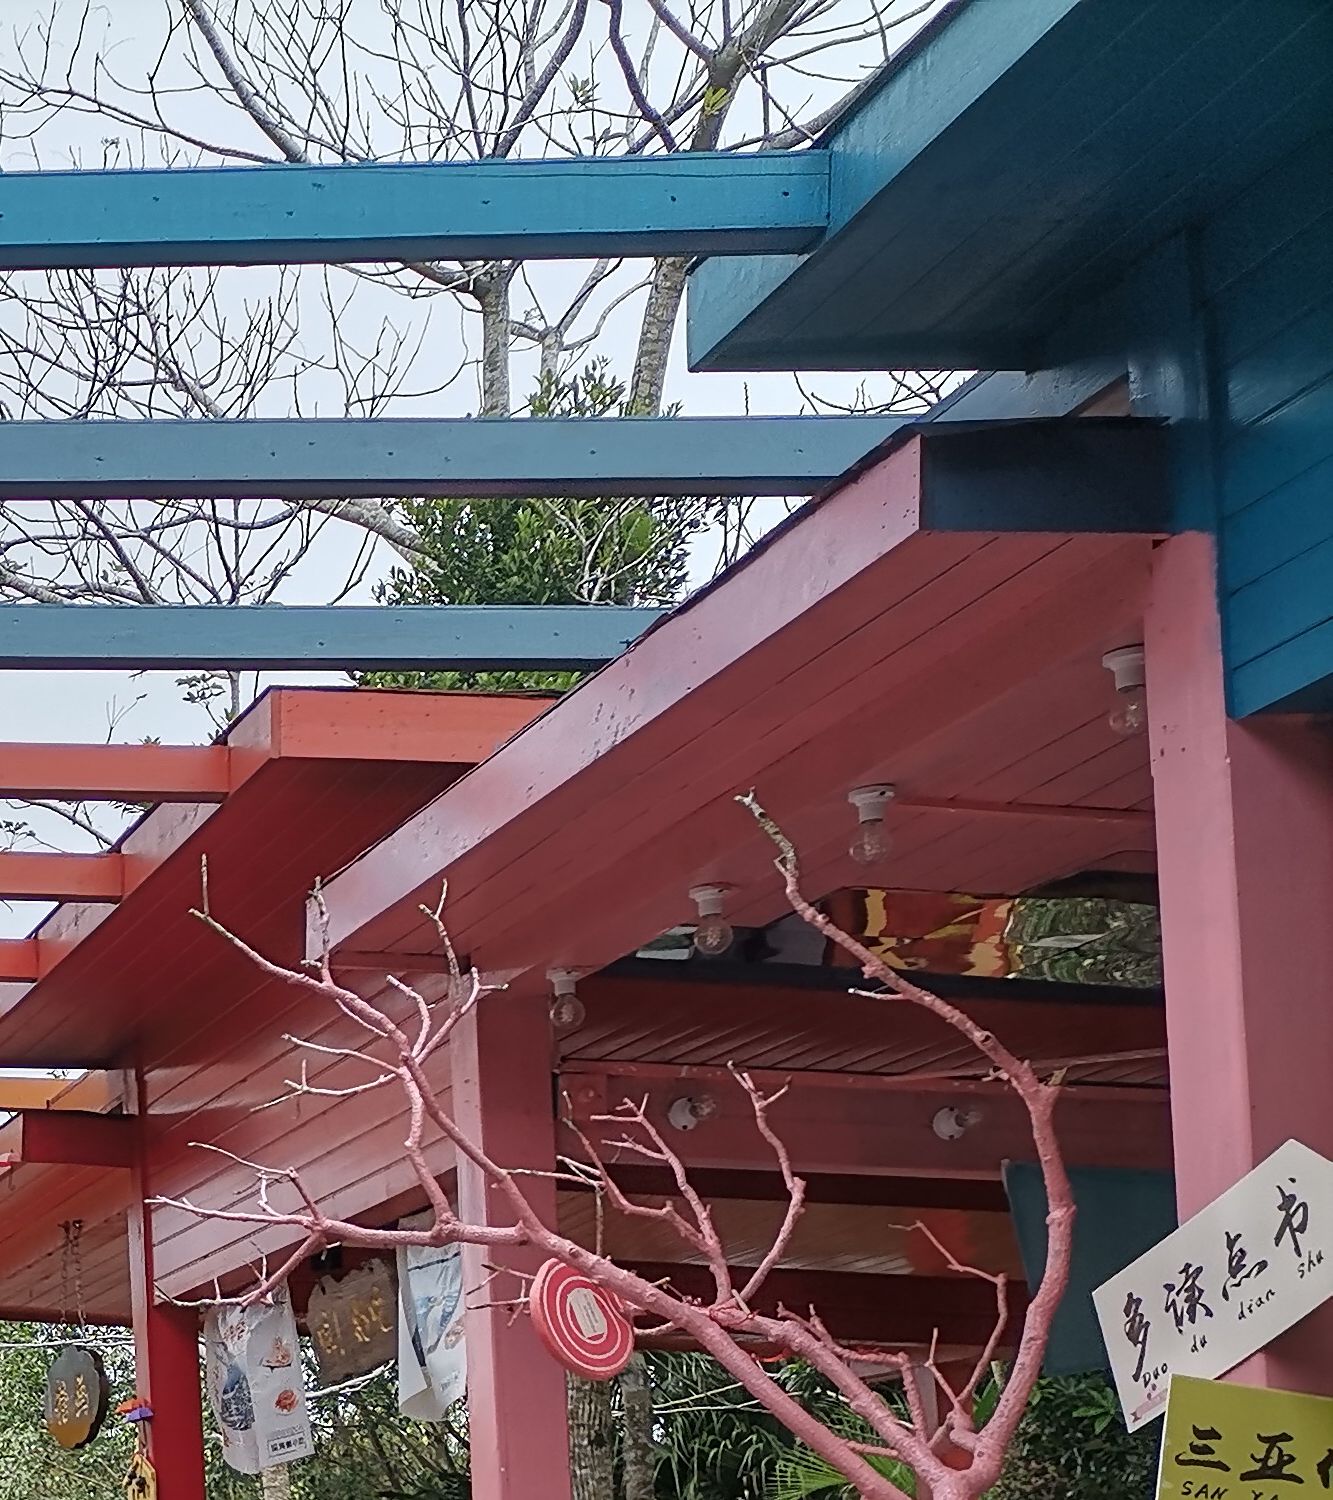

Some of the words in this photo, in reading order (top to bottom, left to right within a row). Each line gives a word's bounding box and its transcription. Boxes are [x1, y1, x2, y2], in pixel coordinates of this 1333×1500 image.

[1123, 1178, 1309, 1381] 多读点书
[1181, 1481, 1229, 1500] SAN
